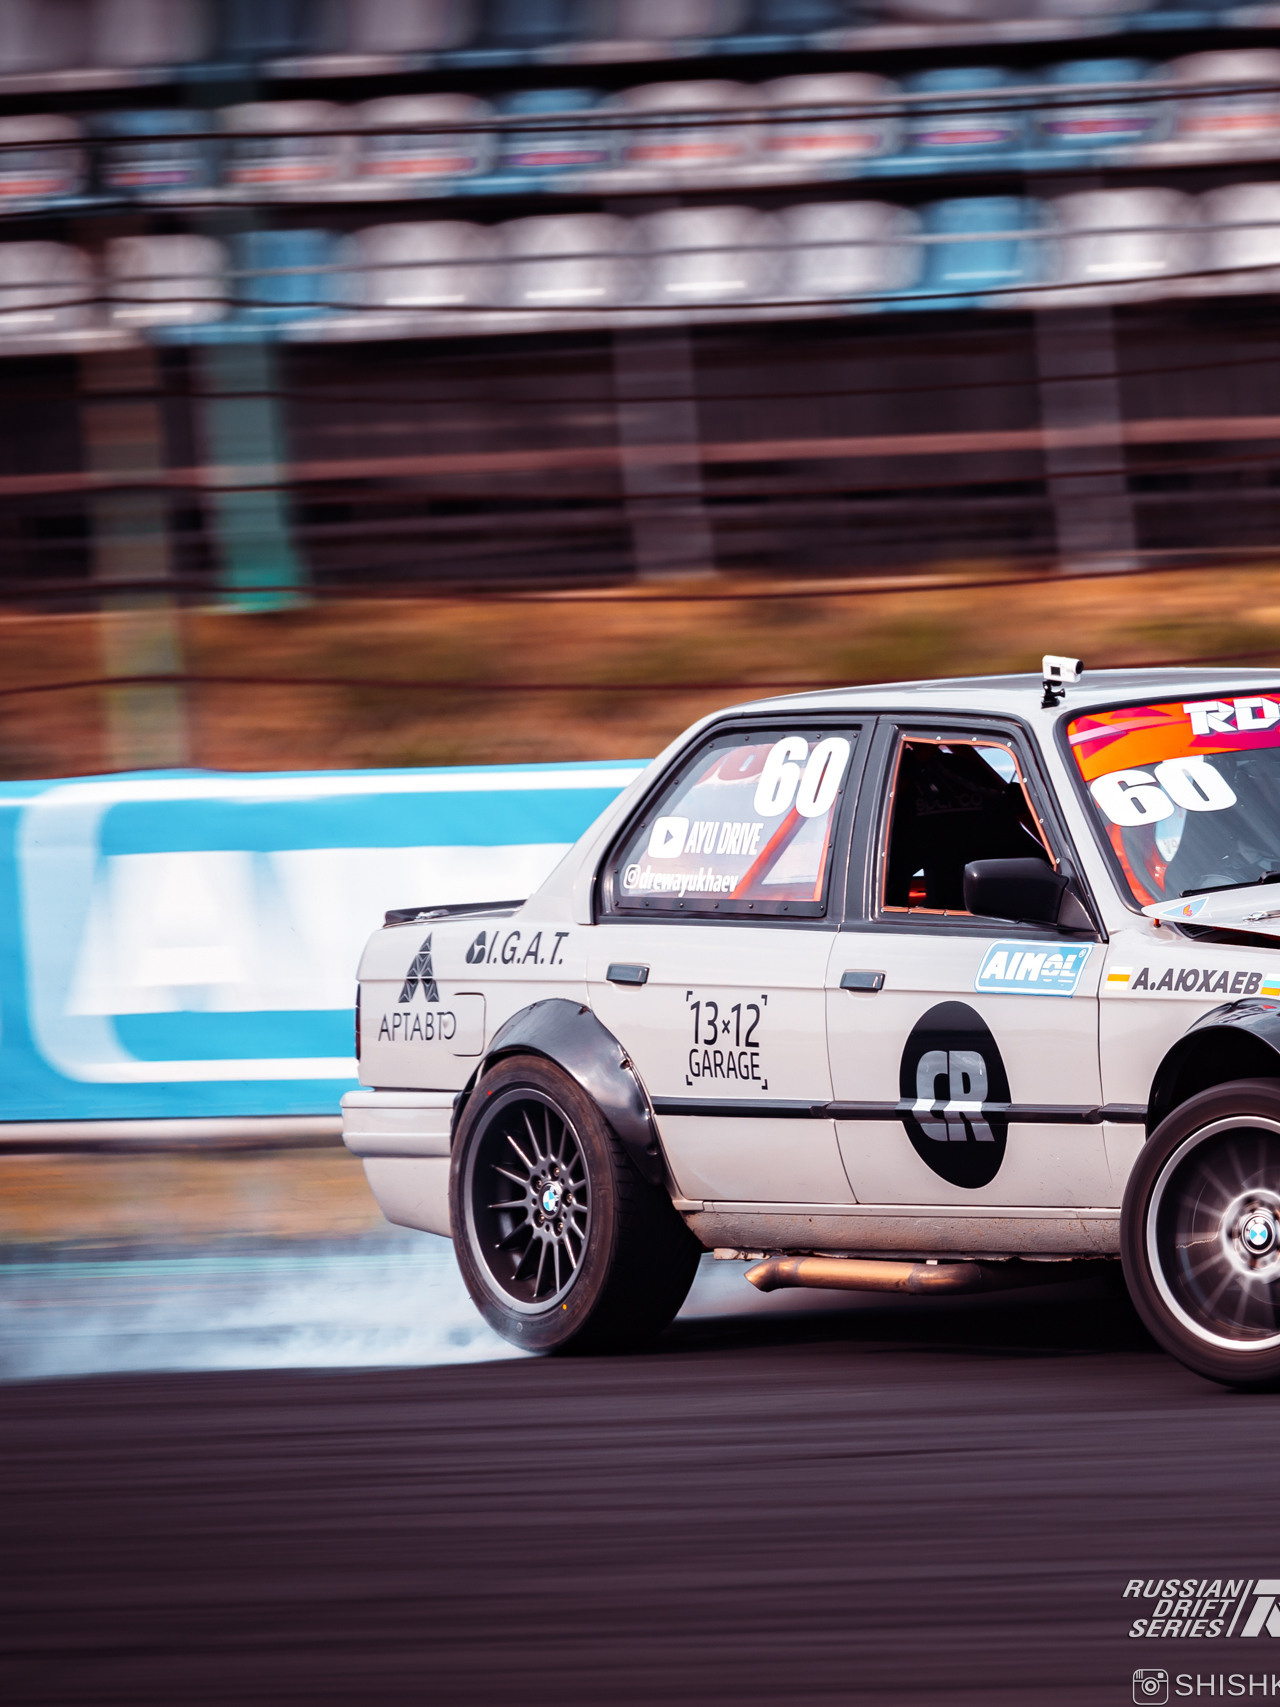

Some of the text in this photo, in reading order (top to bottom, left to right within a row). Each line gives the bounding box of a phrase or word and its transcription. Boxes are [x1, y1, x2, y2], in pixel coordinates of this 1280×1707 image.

[753, 736, 850, 818] 60
[1089, 755, 1237, 827] 60
[716, 822, 764, 856] DRIVE
[980, 950, 1078, 984] AIMOL
[1131, 967, 1264, 996] А.АЮХАЕВ
[688, 1048, 761, 1081] GARAGE
[911, 1050, 995, 1142] CR
